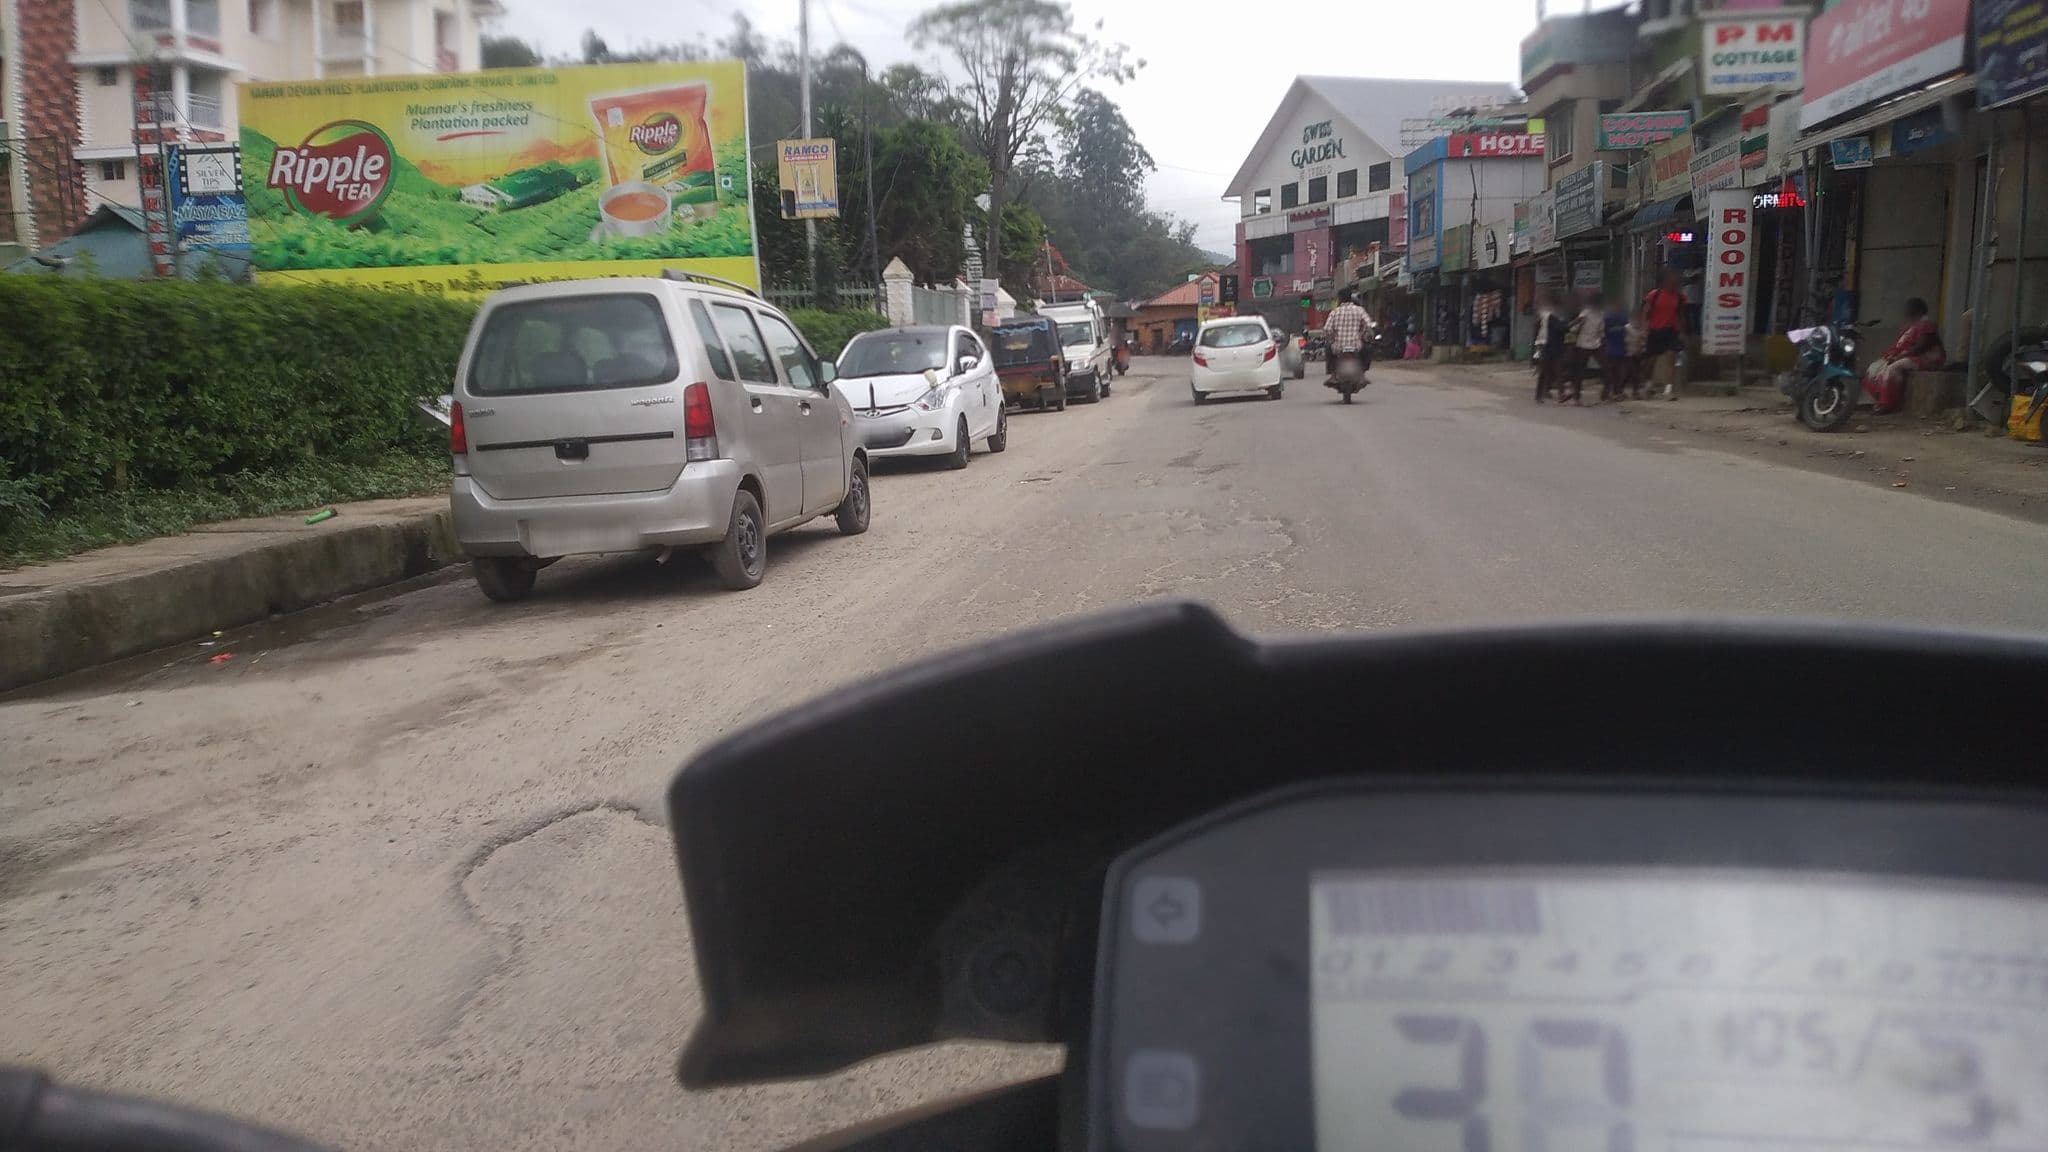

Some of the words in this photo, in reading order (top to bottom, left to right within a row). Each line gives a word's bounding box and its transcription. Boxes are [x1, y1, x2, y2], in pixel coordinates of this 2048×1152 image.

[1712, 49, 1797, 66] COTTAGE
[405, 101, 467, 116] Munnar's
[470, 100, 533, 115] freshness
[410, 116, 478, 130] Plantation
[481, 114, 529, 129] packed
[630, 120, 678, 145] Ripple
[1303, 120, 1333, 145] SWISS
[784, 144, 829, 156] RAMCO
[1291, 137, 1346, 169] GARDEN
[195, 169, 225, 178] SILVER
[270, 145, 385, 194] Ripple
[202, 178, 220, 187] TIPS
[335, 182, 372, 201] TEA
[1717, 208, 1747, 309] ROOMS
